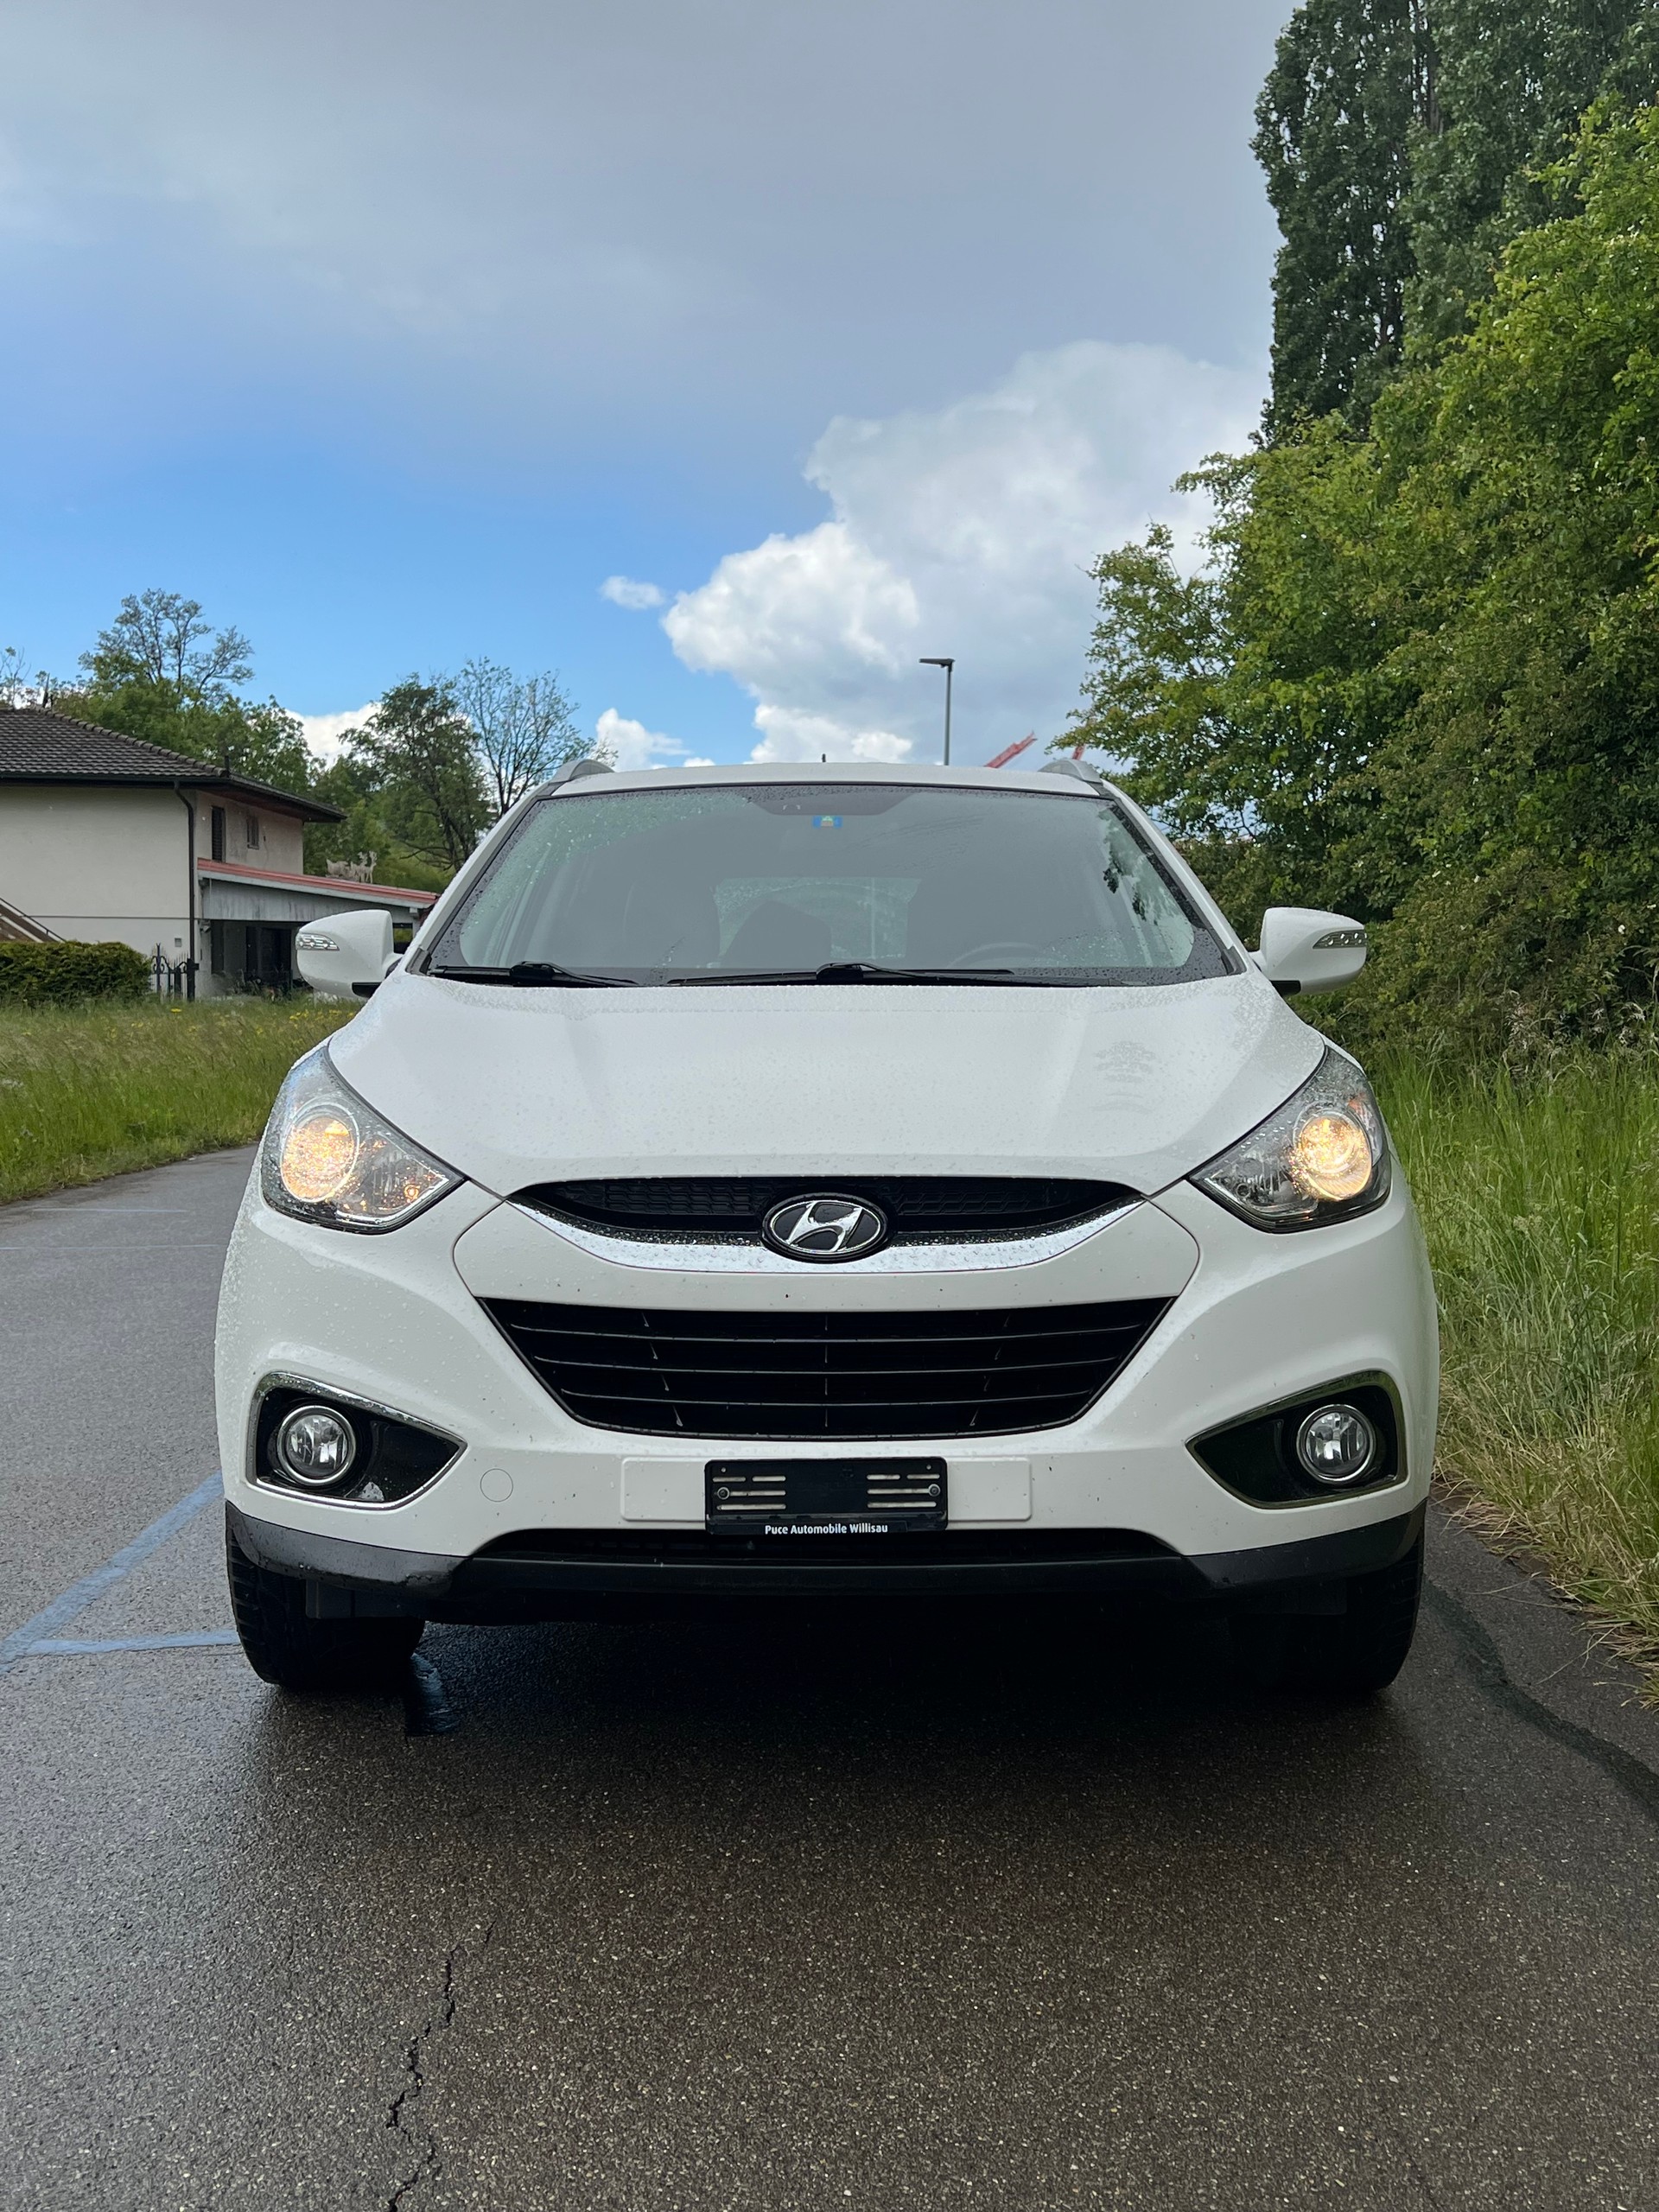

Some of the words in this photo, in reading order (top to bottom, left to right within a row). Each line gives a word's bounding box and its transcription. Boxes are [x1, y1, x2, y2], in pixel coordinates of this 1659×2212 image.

[765, 1524, 788, 1535] Puce
[790, 1523, 847, 1535] Automobile
[849, 1522, 888, 1534] Willisau
